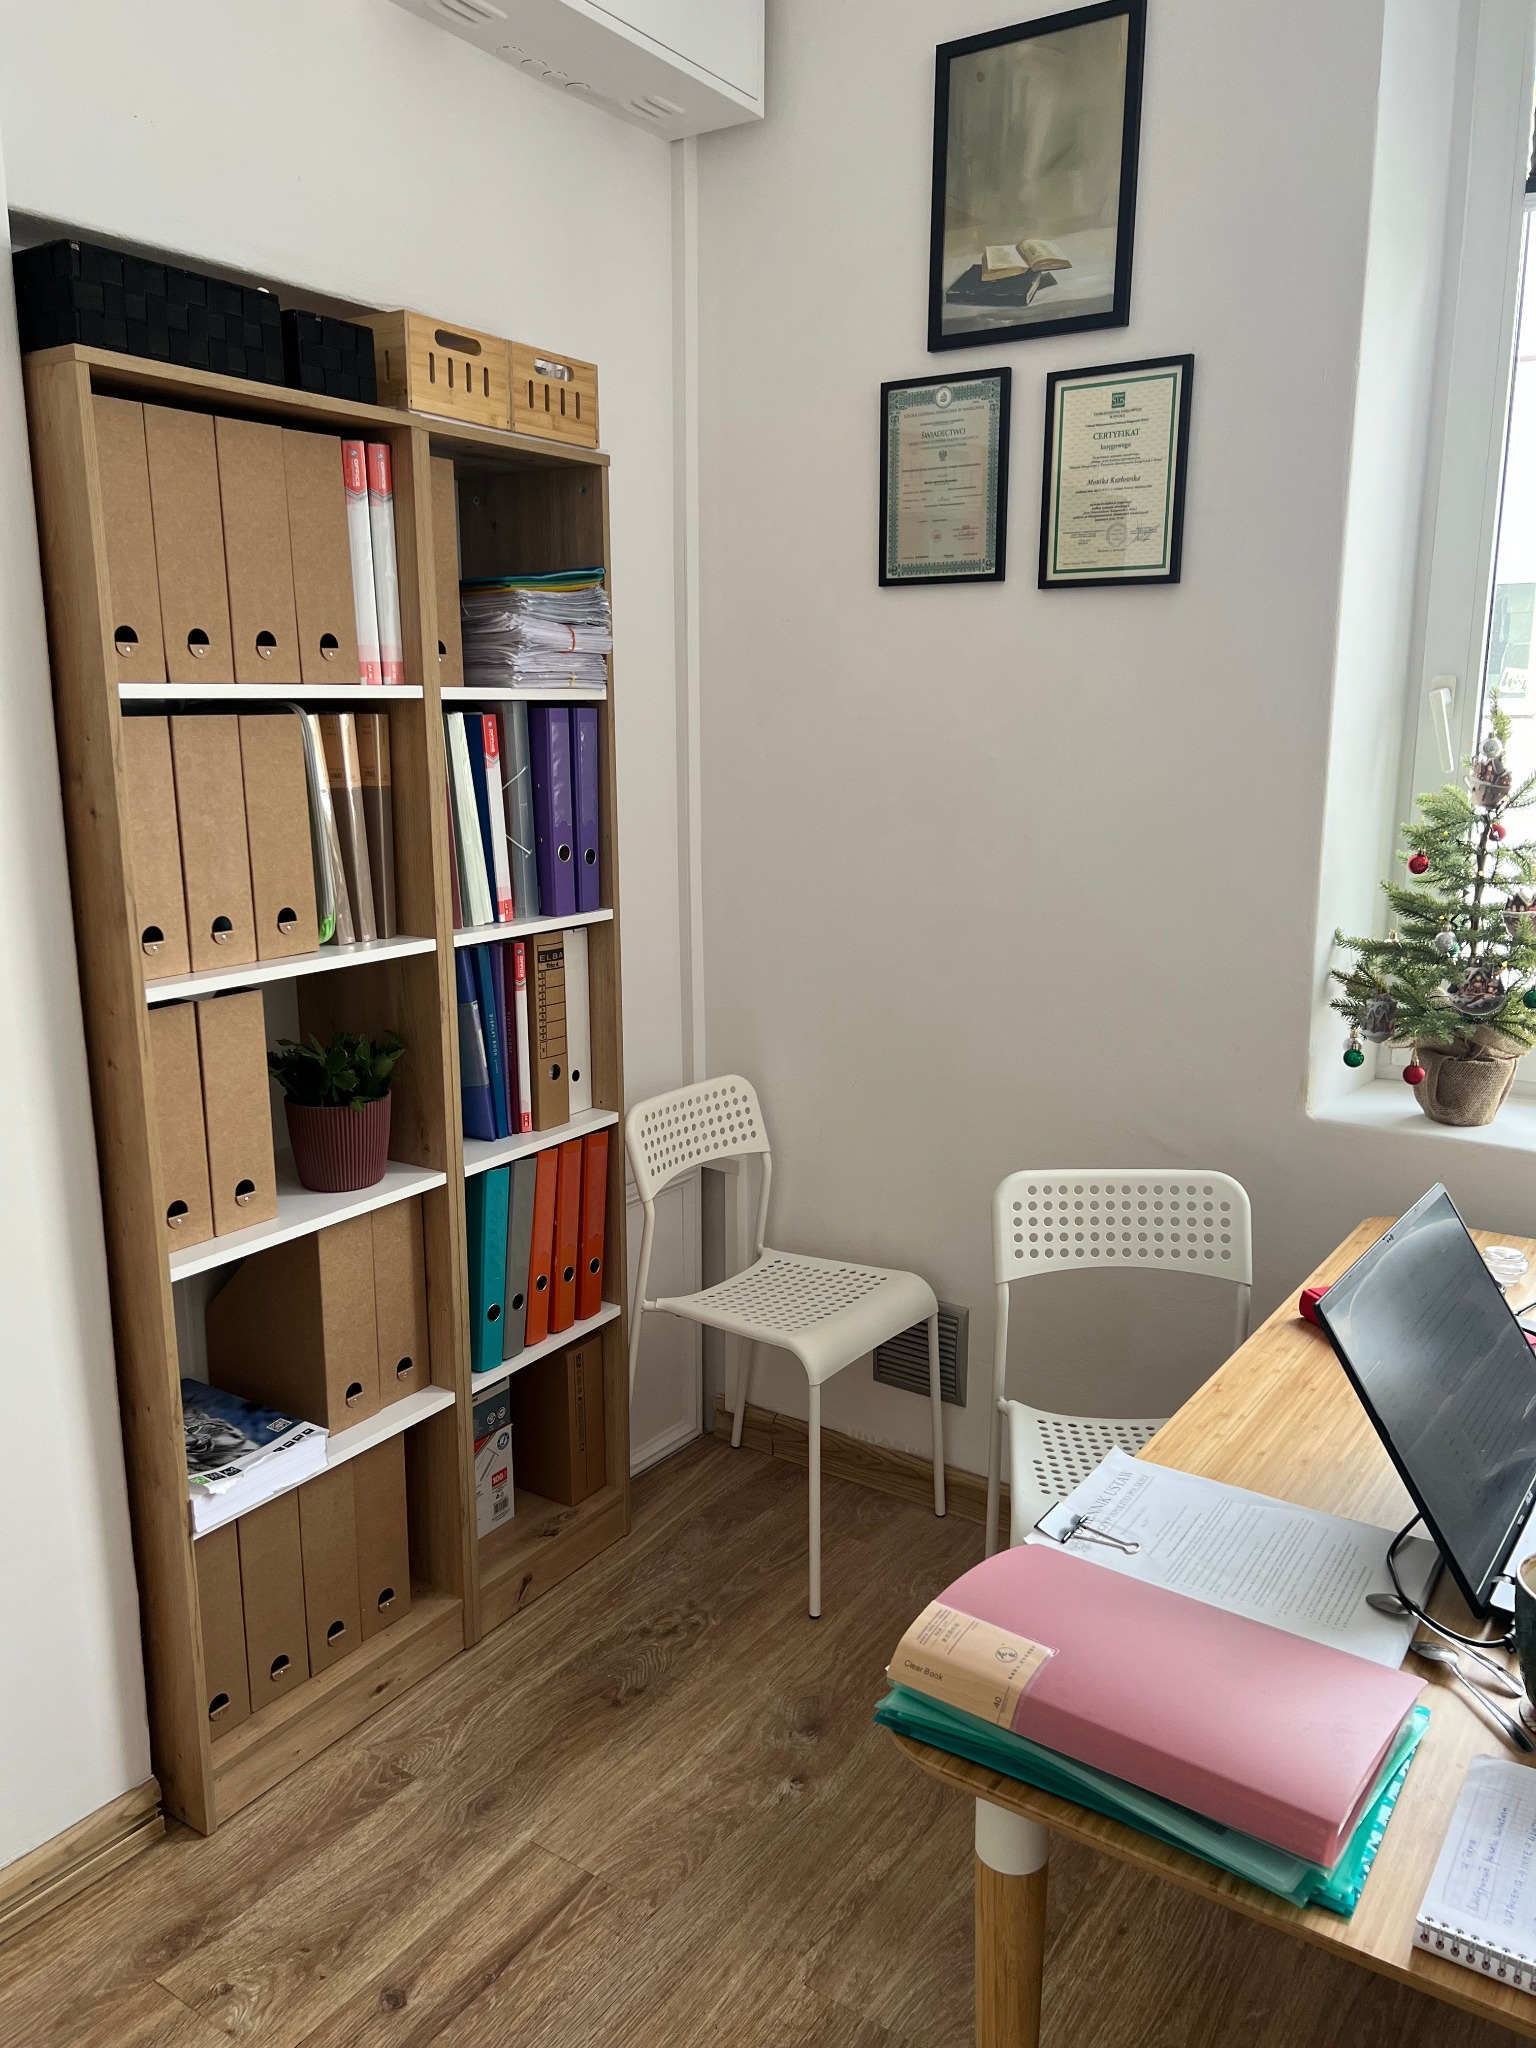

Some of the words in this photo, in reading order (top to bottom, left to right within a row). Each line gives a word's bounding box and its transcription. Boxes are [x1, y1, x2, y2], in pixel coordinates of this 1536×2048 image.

[921, 428, 966, 439] ŚWIADECTWO
[1092, 428, 1141, 440] CERTYFIKAT
[1100, 442, 1132, 451] księgowego
[1086, 477, 1109, 486] Monika
[538, 950, 564, 962] ELBA
[1101, 1469, 1132, 1496] USTAW
[904, 1659, 924, 1673] Clear
[924, 1667, 944, 1681] Book
[993, 1696, 1003, 1709] 40
